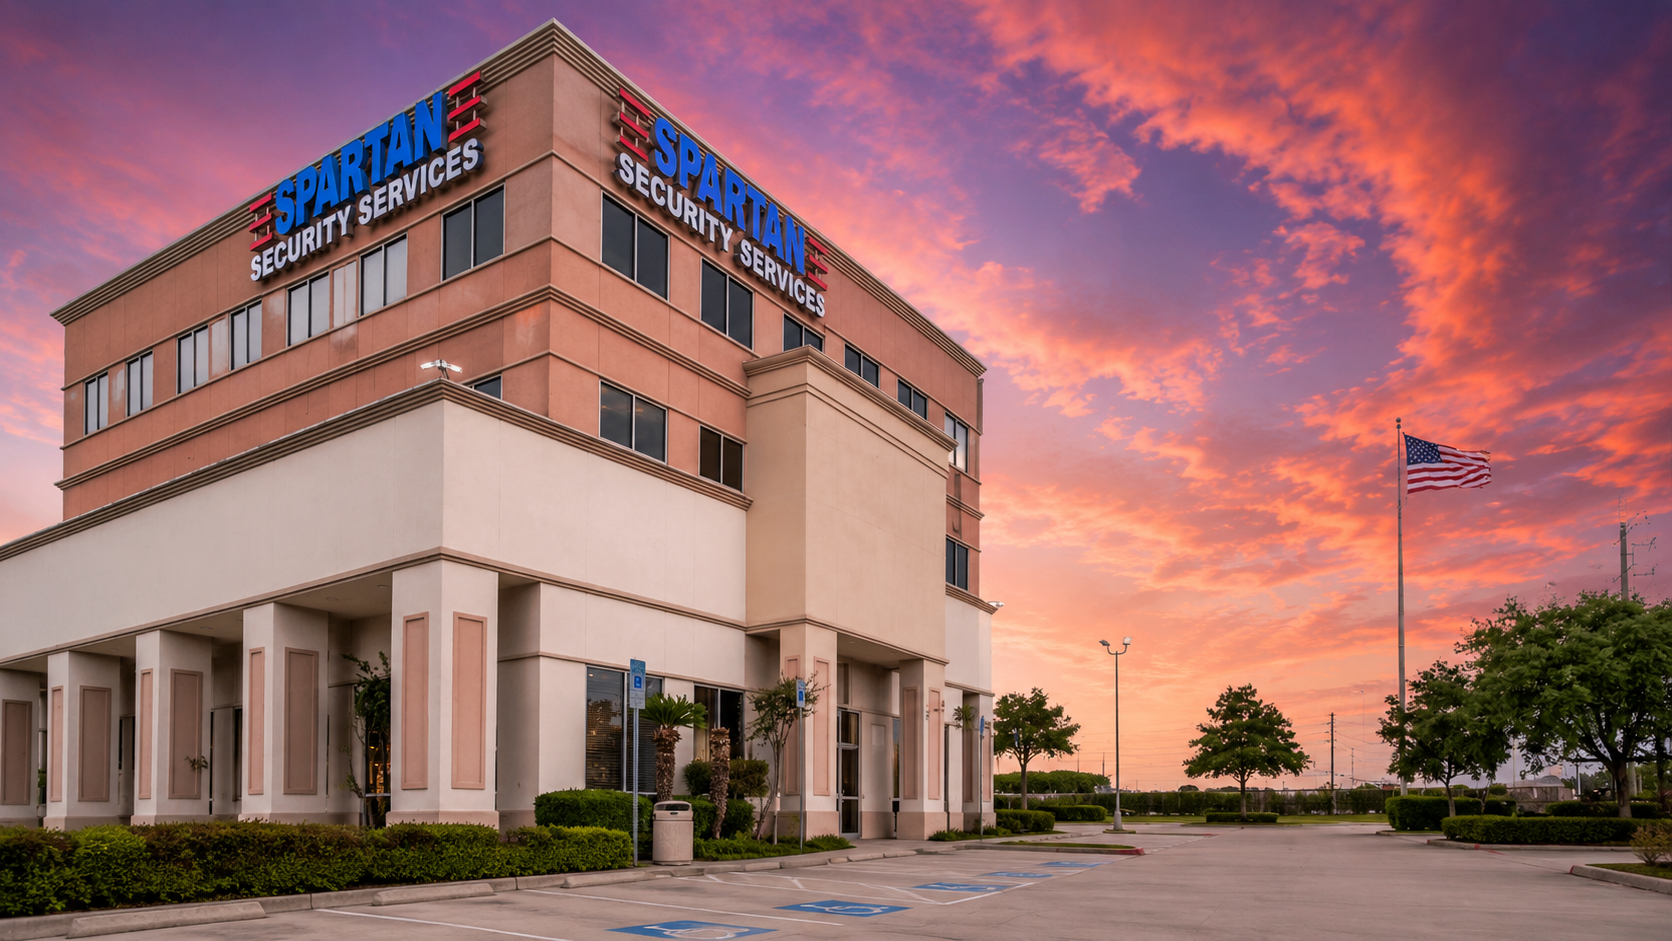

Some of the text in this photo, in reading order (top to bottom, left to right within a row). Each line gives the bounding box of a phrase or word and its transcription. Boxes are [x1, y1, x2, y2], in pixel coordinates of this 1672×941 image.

[250, 138, 482, 282] SECURITY SERVICES
[275, 91, 445, 235] SPARTAN
[617, 152, 825, 318] SECURITY SERVICES
[654, 117, 805, 275] SPARTAN
